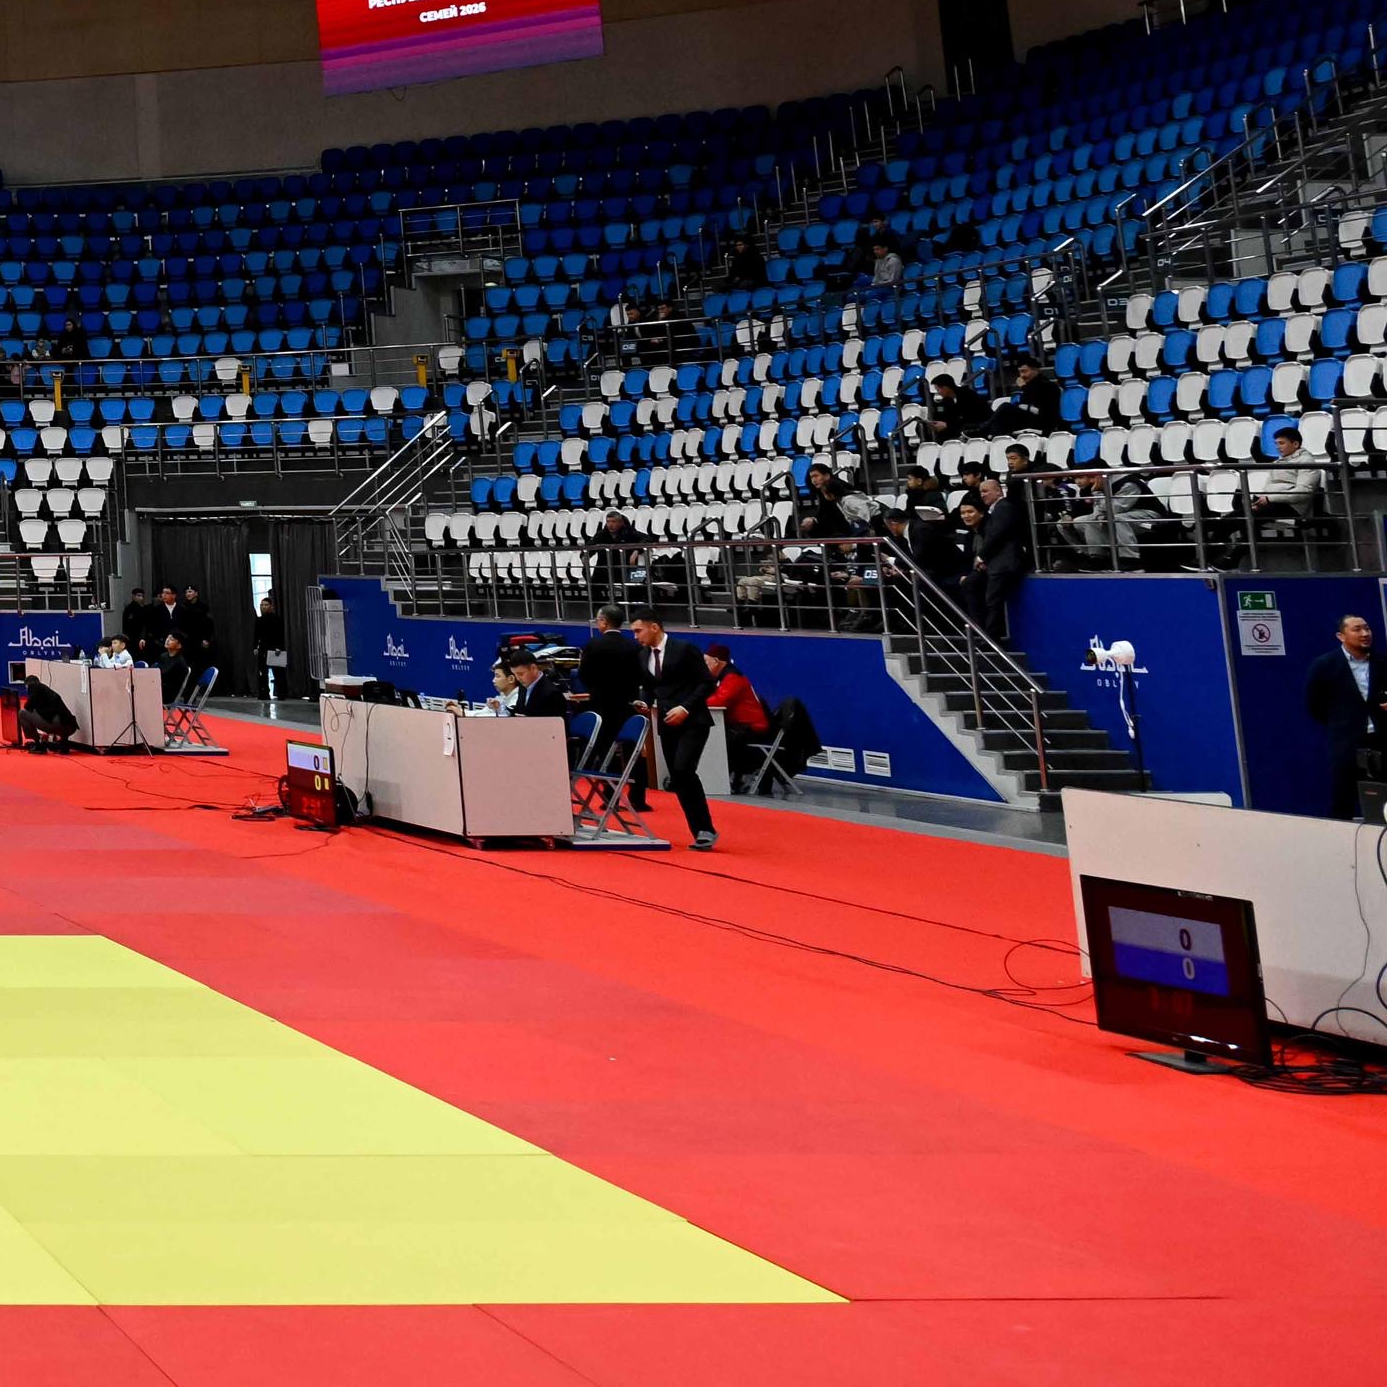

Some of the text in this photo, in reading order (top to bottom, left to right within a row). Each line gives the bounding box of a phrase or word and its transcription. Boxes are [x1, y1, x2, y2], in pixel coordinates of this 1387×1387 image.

[419, 2, 486, 23] СЕМЕЙ 2026
[1097, 678, 1139, 690] OBLY
[313, 754, 320, 770] 0
[314, 774, 322, 791] 0
[1179, 928, 1192, 951] 0
[1182, 957, 1195, 980] 0
